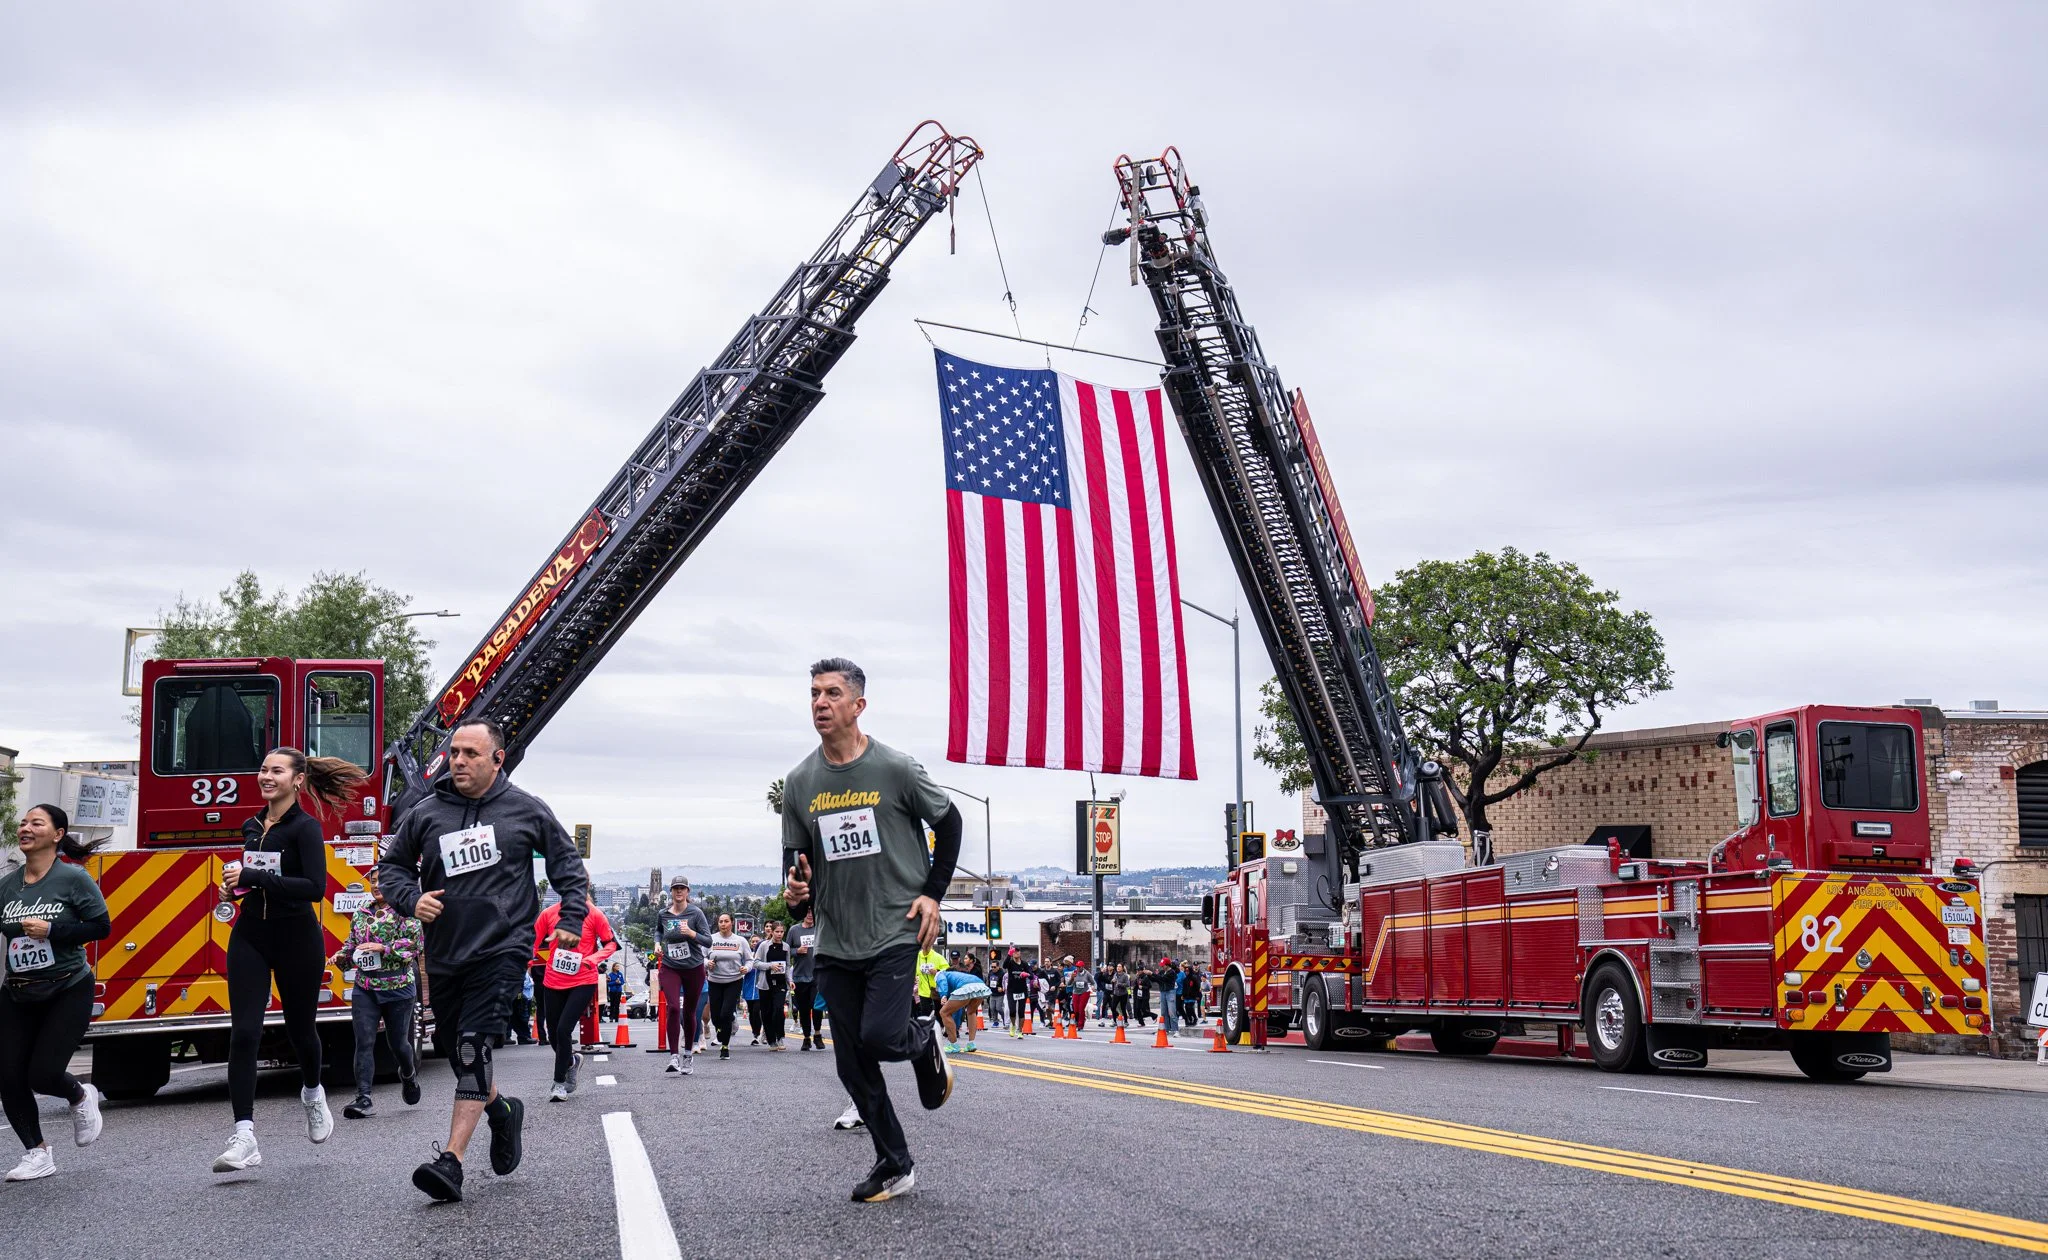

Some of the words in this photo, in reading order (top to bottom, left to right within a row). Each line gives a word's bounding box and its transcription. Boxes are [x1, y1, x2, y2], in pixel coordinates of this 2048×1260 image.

[1313, 443, 1341, 516] COUNTY
[1340, 521, 1356, 565] FIRE
[464, 551, 578, 687] PASADENA
[191, 777, 238, 805] 32
[809, 789, 881, 813] Altadena
[830, 830, 873, 854] 1394
[1095, 832, 1112, 843] STOP
[449, 843, 492, 869] 1106
[1826, 885, 1843, 895] LOS
[1847, 886, 1887, 896] ANGELES
[1889, 887, 1925, 898] COUNTY
[1, 896, 65, 918] Altadena
[1853, 900, 1873, 909] FIRE
[5, 914, 54, 924] CALIRNIA
[1944, 913, 1973, 922] 1510441
[1801, 914, 1844, 953] 82
[14, 949, 48, 968] 1426
[671, 949, 688, 959] 1136
[556, 959, 577, 971] 1993
[1664, 1050, 1695, 1058] Pierce
[1846, 1055, 1878, 1063] Pierce
